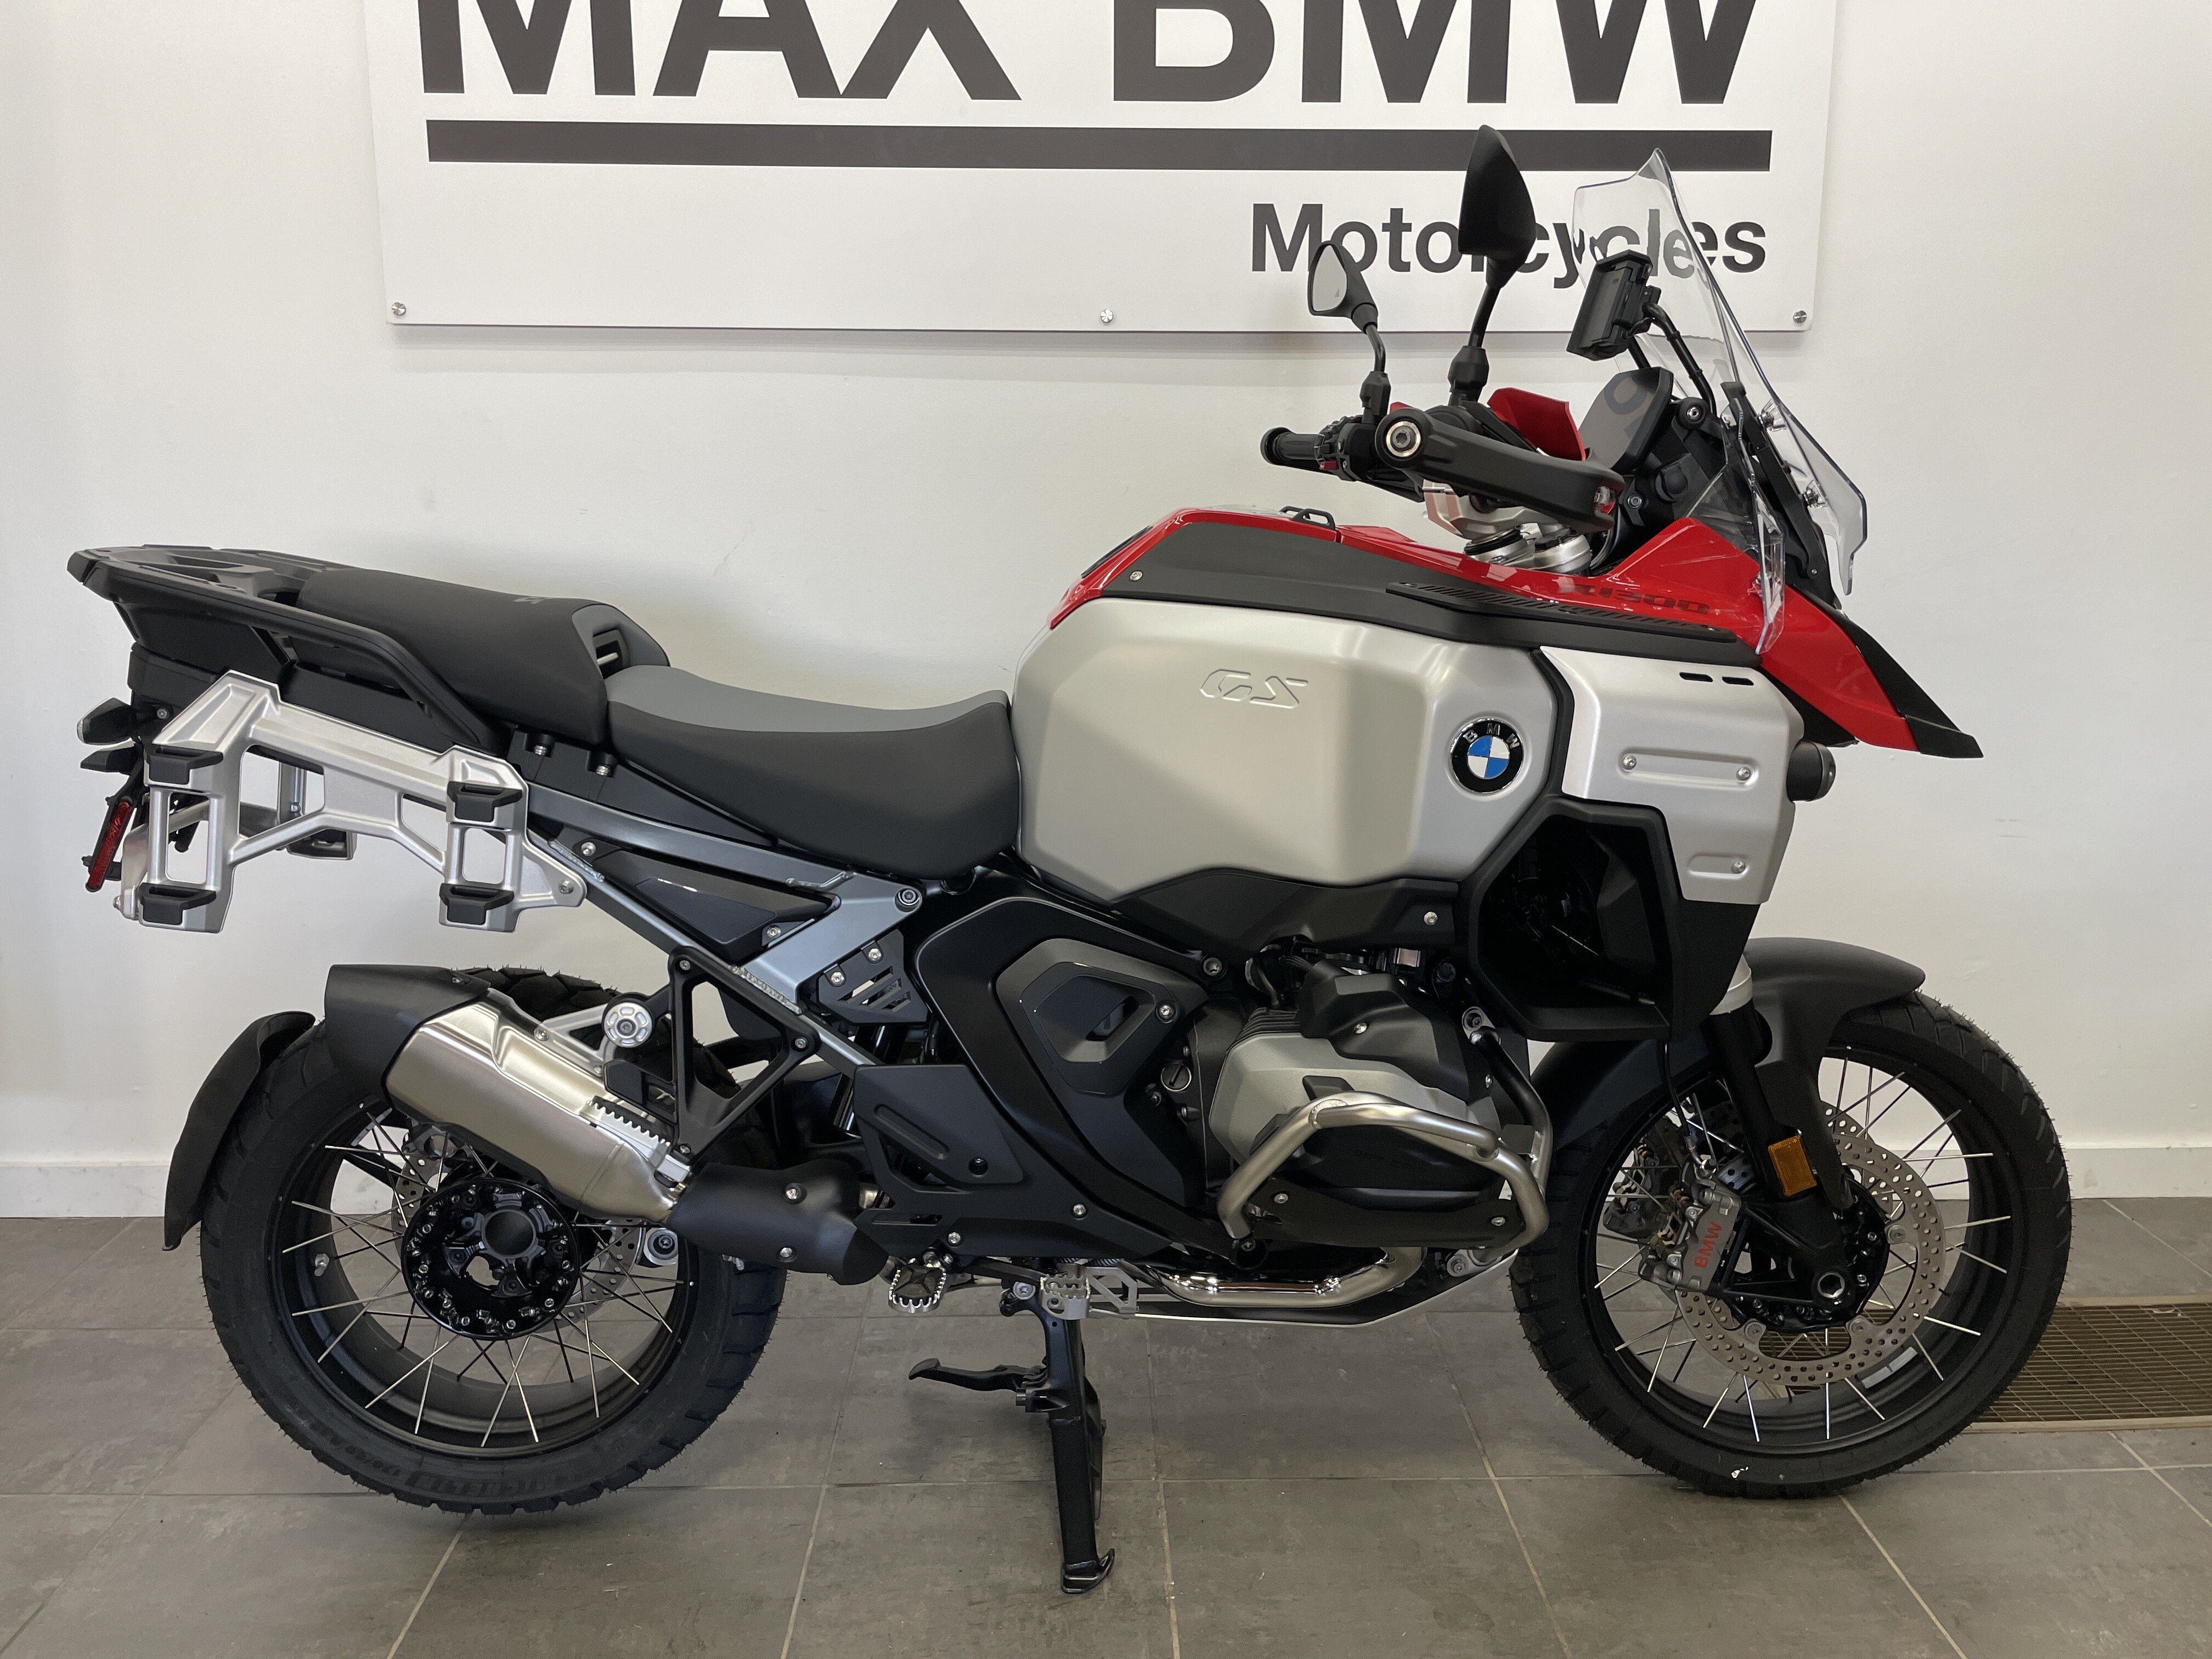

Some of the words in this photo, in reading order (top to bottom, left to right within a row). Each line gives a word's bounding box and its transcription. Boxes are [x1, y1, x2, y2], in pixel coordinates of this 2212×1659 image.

[1251, 203, 1766, 289] Motoycles
[1200, 669, 1308, 709] GS
[1463, 723, 1520, 750] BMW
[1694, 1221, 1722, 1269] BMW
